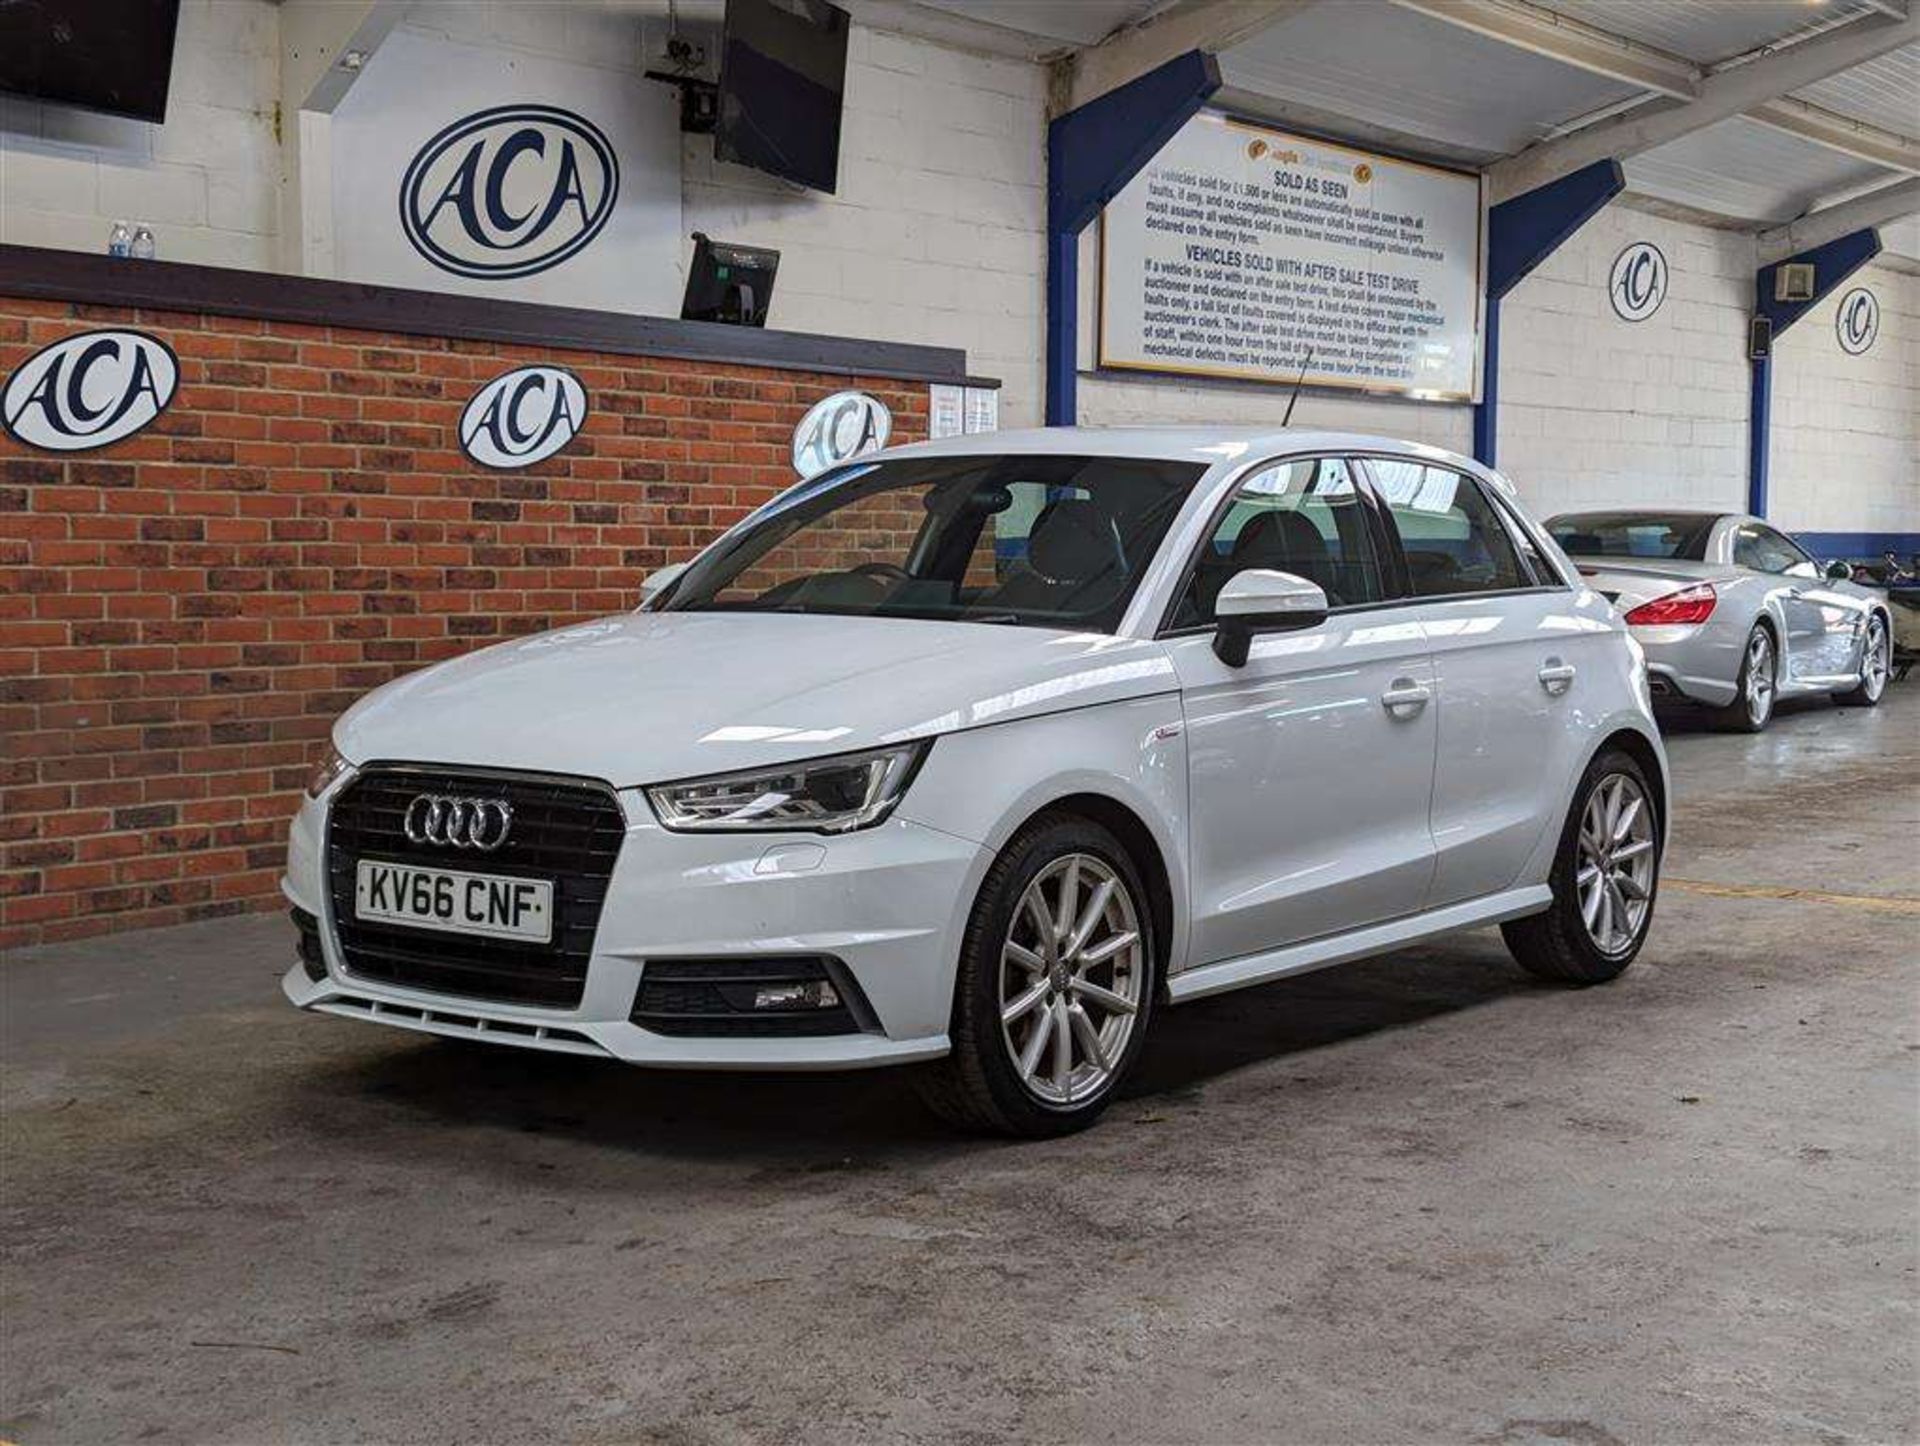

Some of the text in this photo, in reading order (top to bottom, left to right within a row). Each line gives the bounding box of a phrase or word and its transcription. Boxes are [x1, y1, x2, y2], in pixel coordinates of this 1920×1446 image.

[424, 128, 591, 249] ACA
[1274, 170, 1348, 198] SOLD AS SEEN
[1146, 216, 1184, 233] declared
[1186, 227, 1197, 235] on
[1199, 226, 1213, 237] the
[1215, 228, 1236, 244] entry
[1186, 245, 1418, 294] VEHICLES SOLD WITH AFTER SALE TEST DRIVE
[1617, 250, 1659, 311] ACA
[1317, 299, 1323, 310] A
[10, 338, 160, 436] ACA
[465, 374, 575, 456] ACA
[798, 392, 889, 459] ACA
[370, 867, 536, 927] KV66 CNF
